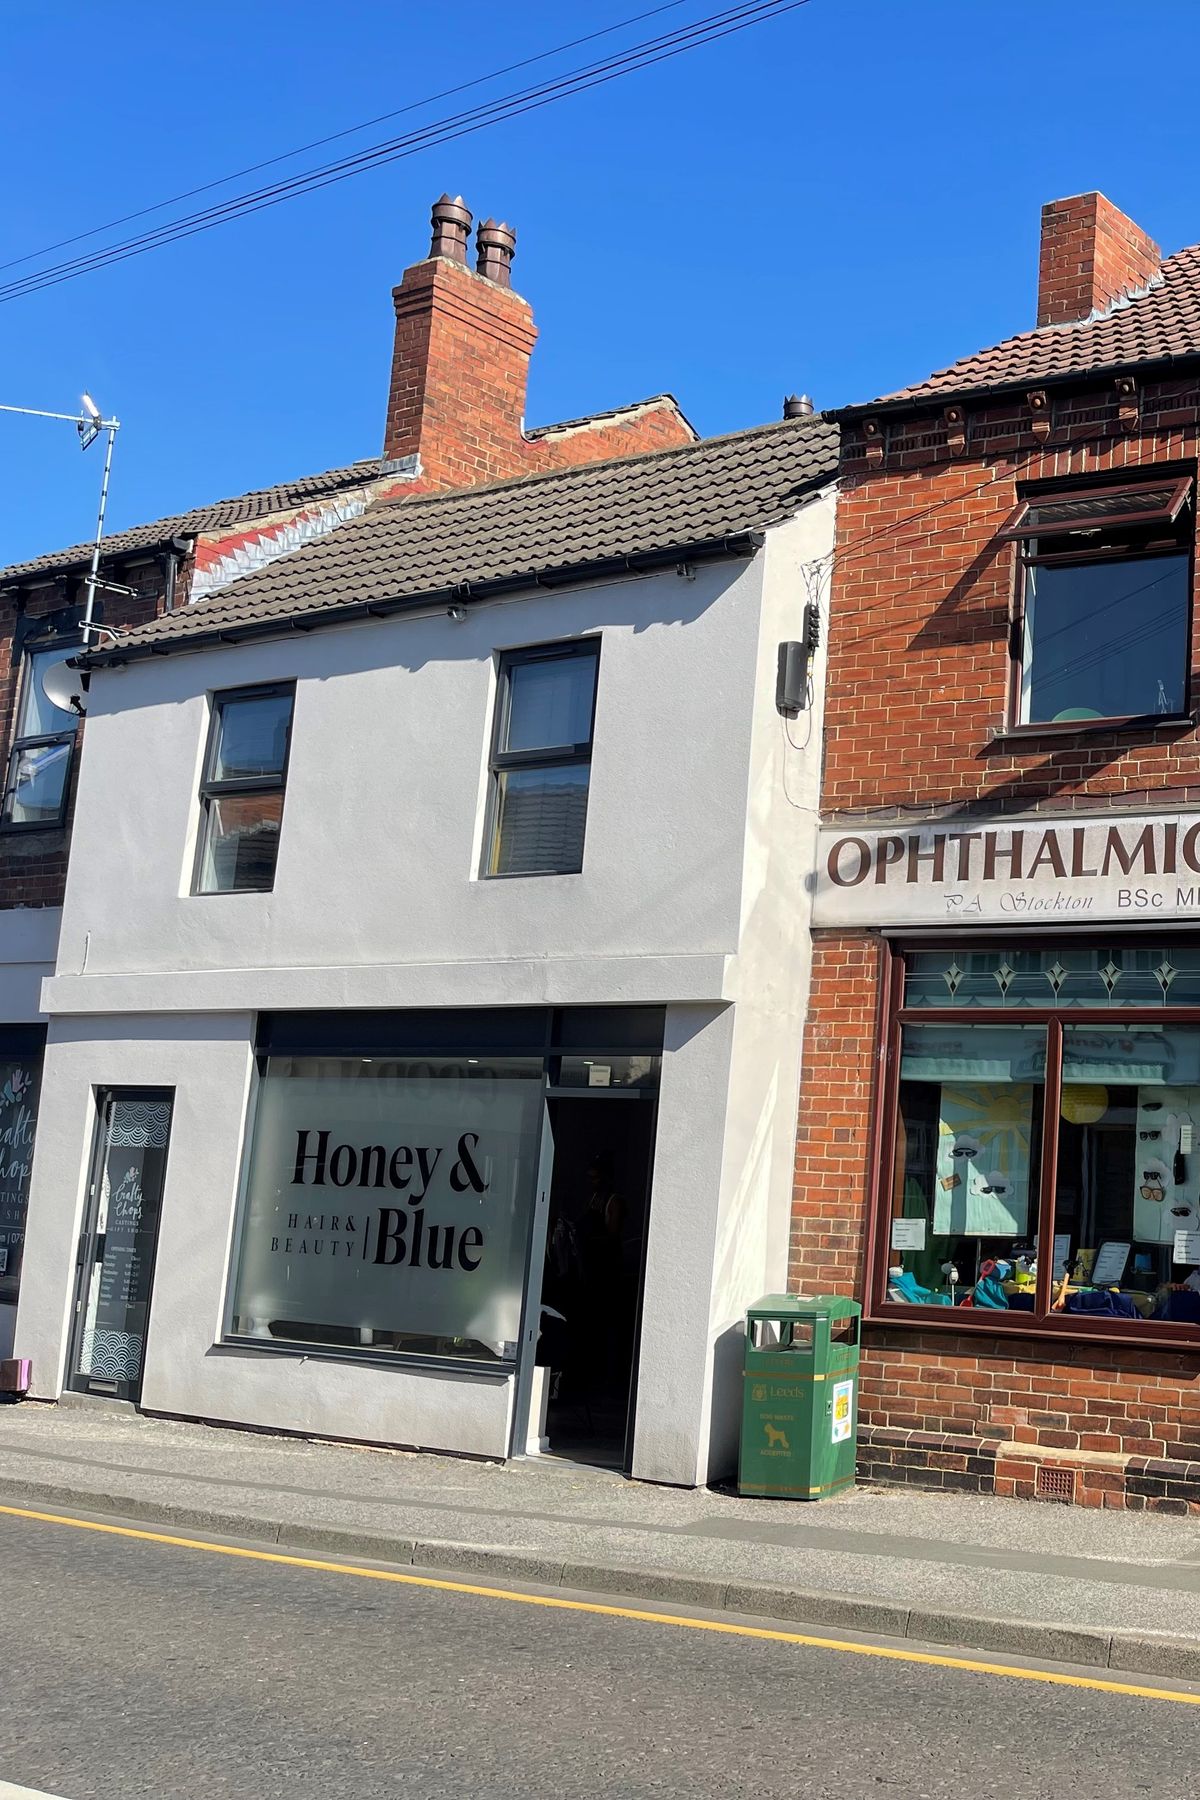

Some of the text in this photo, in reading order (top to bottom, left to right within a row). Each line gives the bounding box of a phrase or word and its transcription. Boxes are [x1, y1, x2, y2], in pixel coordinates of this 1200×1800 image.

[1000, 891, 1094, 913] Stockton
[1117, 889, 1163, 908] BSc
[0, 1104, 36, 1159] afty
[290, 1130, 490, 1206] Honey &
[112, 1182, 146, 1207] Crafty
[114, 1201, 143, 1220] Chops
[271, 1237, 355, 1257] BEAUTY
[372, 1207, 484, 1272] Blue
[770, 1385, 805, 1399] Leeds
[760, 1449, 792, 1457] ACCEPTED
